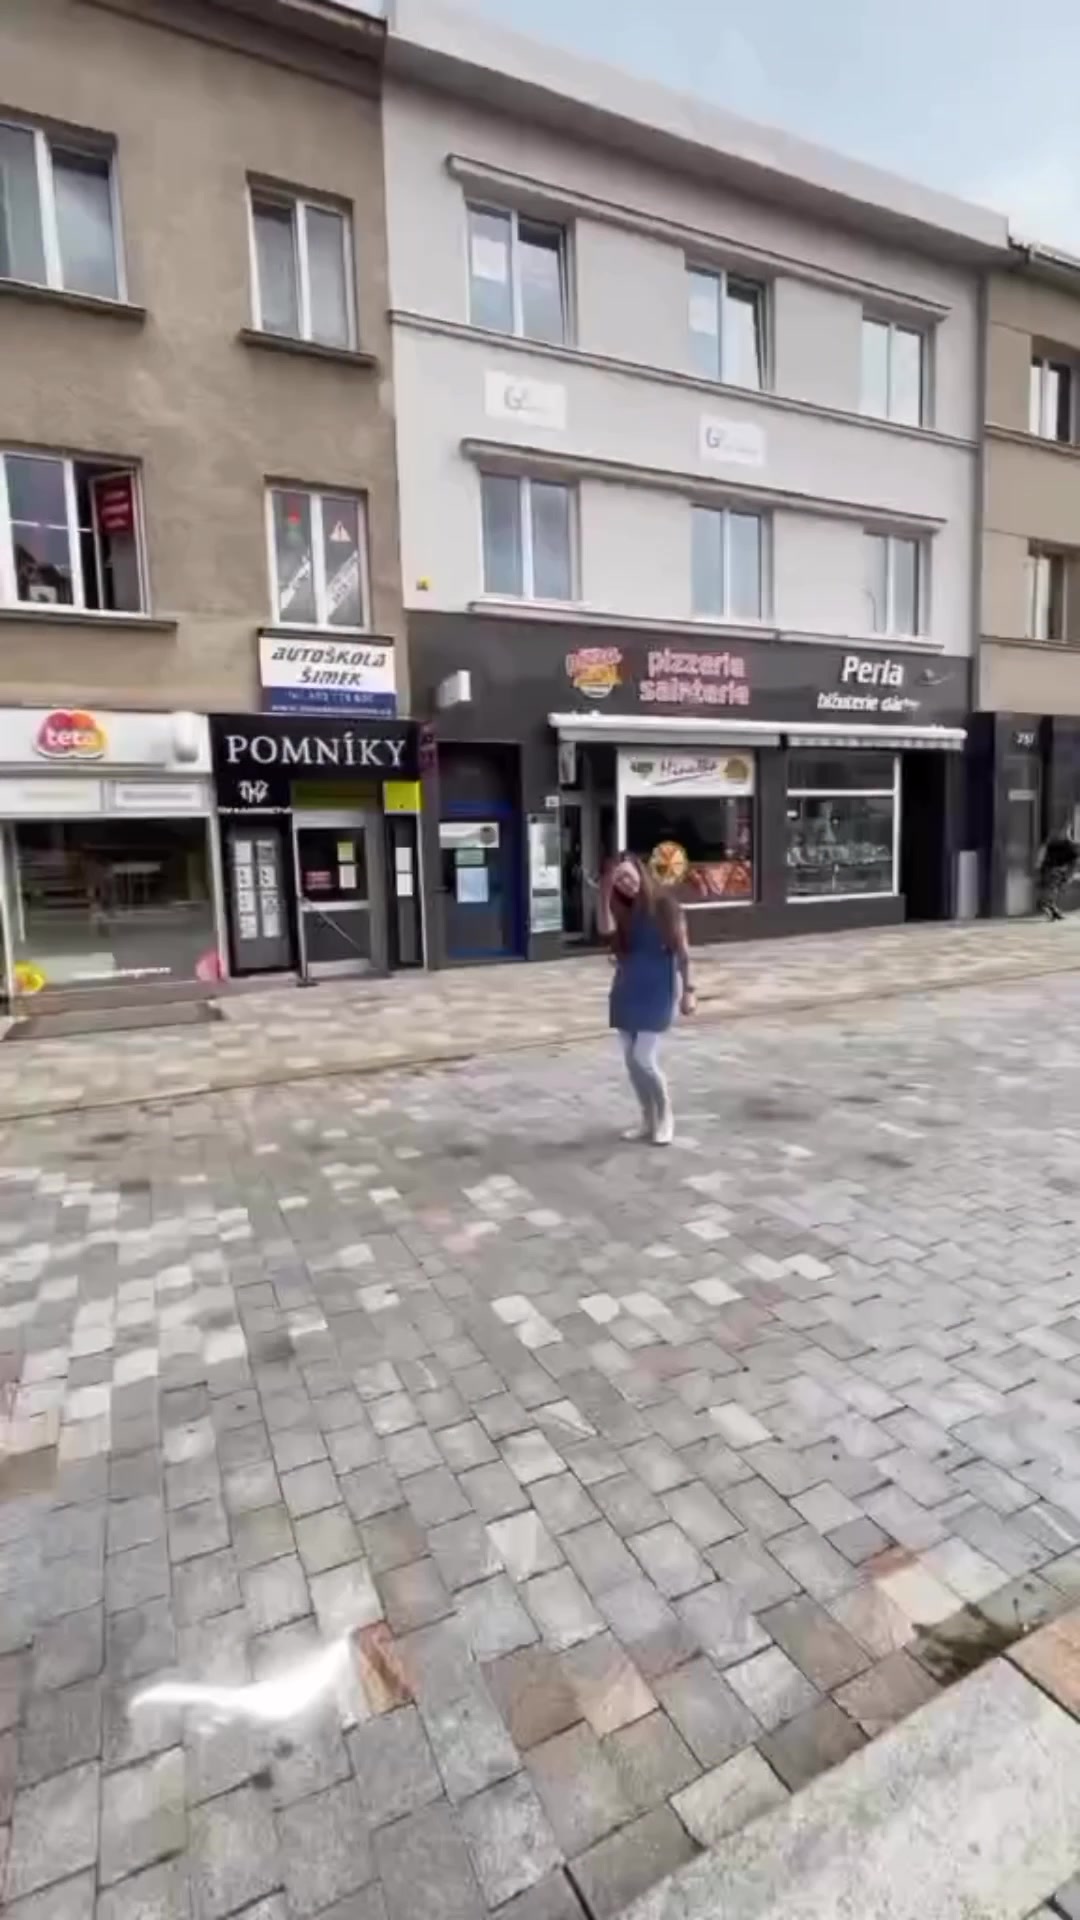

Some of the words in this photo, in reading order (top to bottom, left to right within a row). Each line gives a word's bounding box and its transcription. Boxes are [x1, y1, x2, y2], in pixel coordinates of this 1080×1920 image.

[299, 666, 363, 686] ŠIMEK
[648, 649, 746, 678] pizzeria
[841, 655, 904, 686] Perla
[46, 727, 98, 746] teta
[225, 731, 406, 767] POMNÍKY
